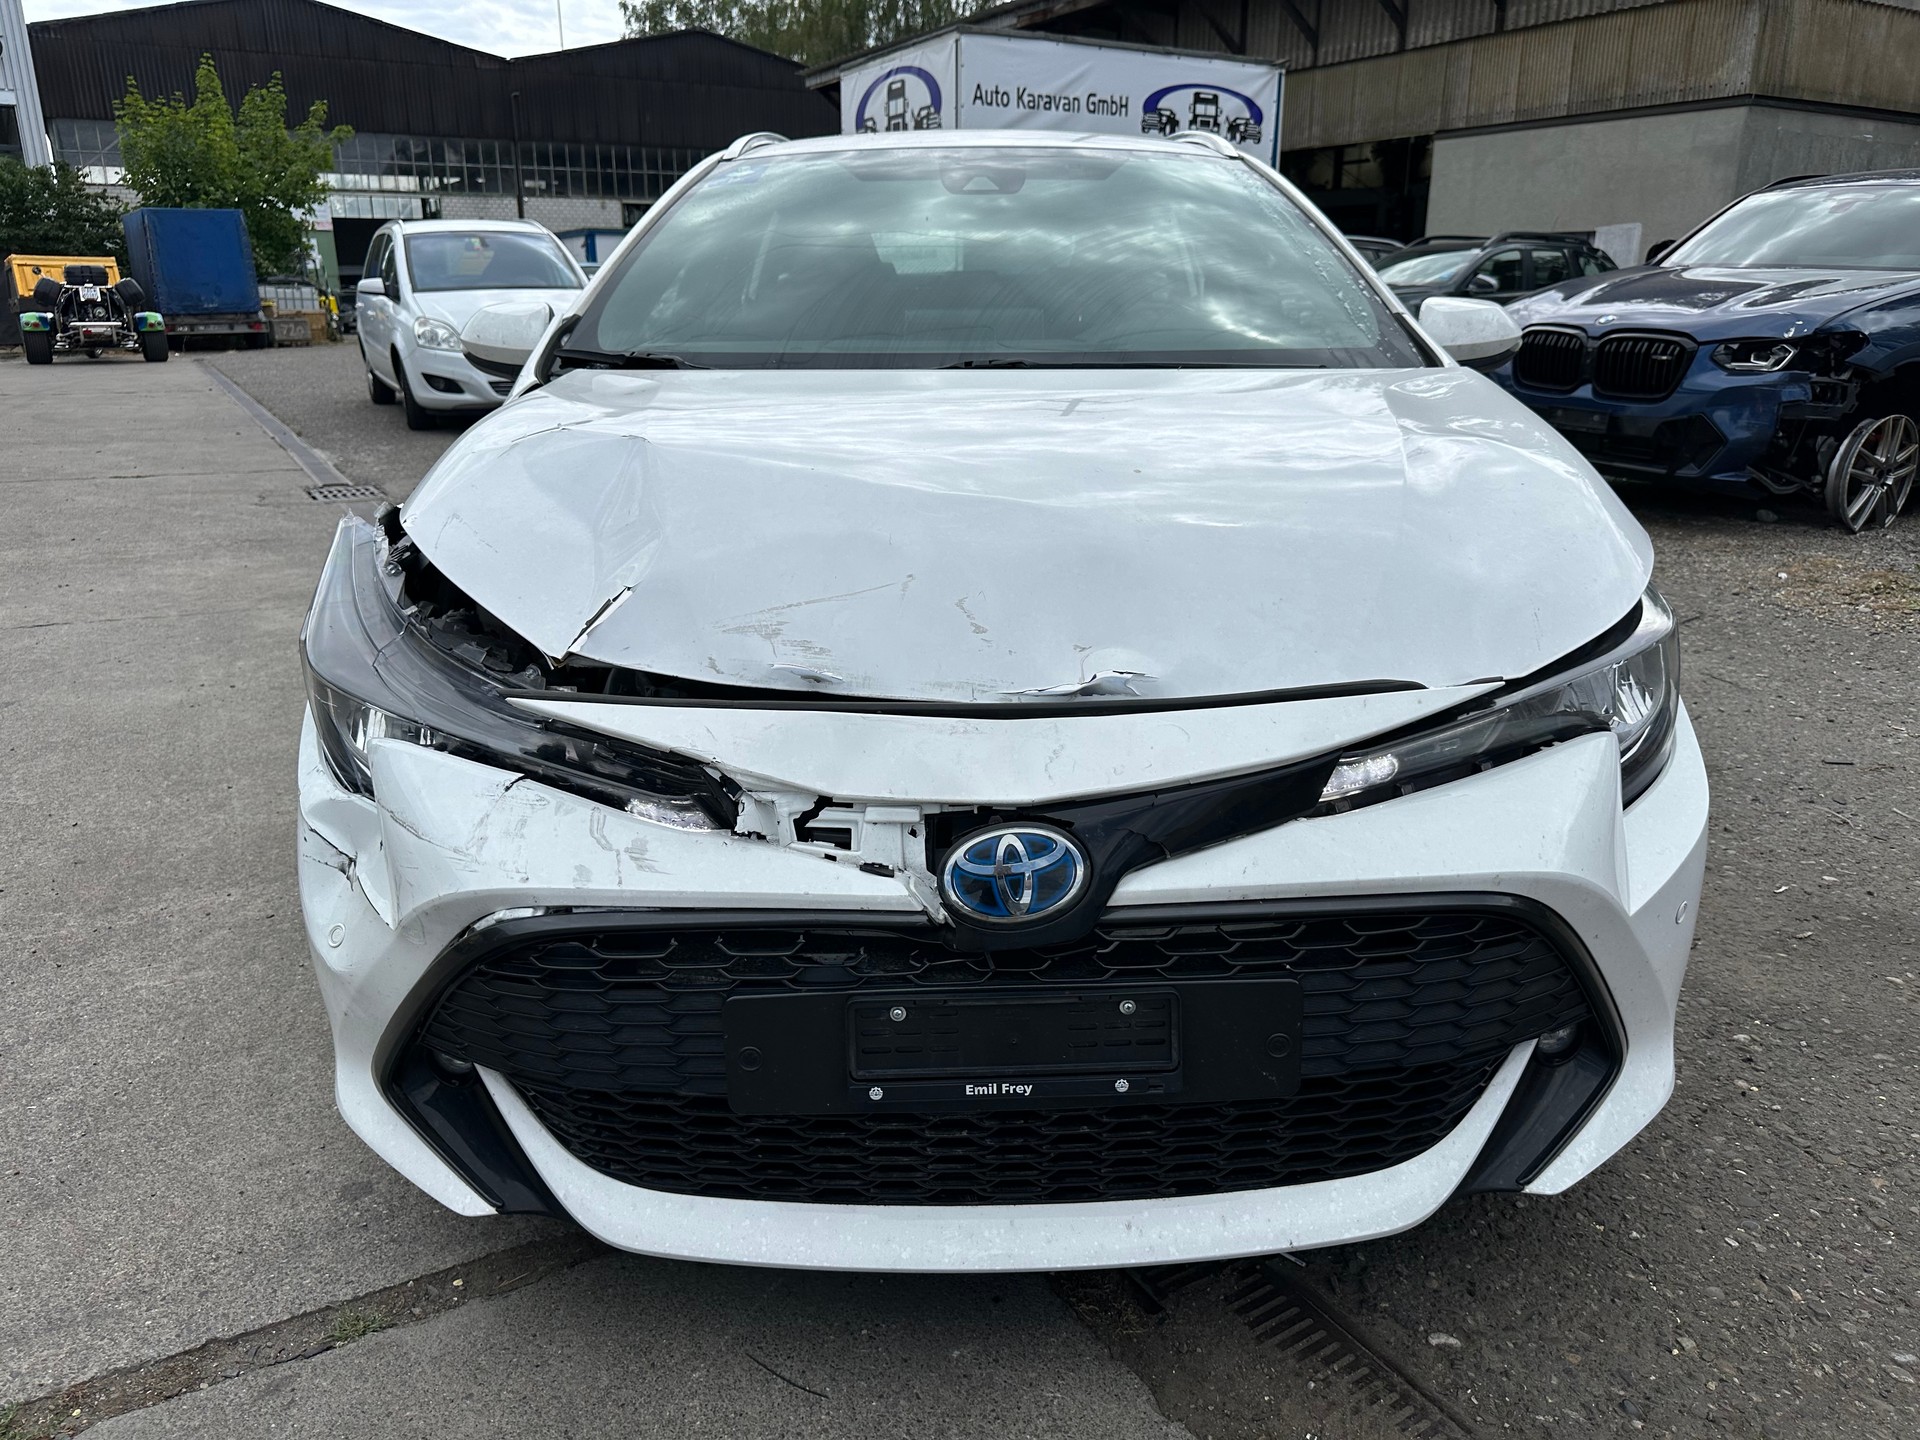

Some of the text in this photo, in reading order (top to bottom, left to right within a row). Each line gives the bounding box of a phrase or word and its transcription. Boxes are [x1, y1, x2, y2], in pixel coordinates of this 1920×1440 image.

[972, 83, 1129, 118] Auto Karavan GmbH
[965, 1083, 1033, 1097] Emil Frey
